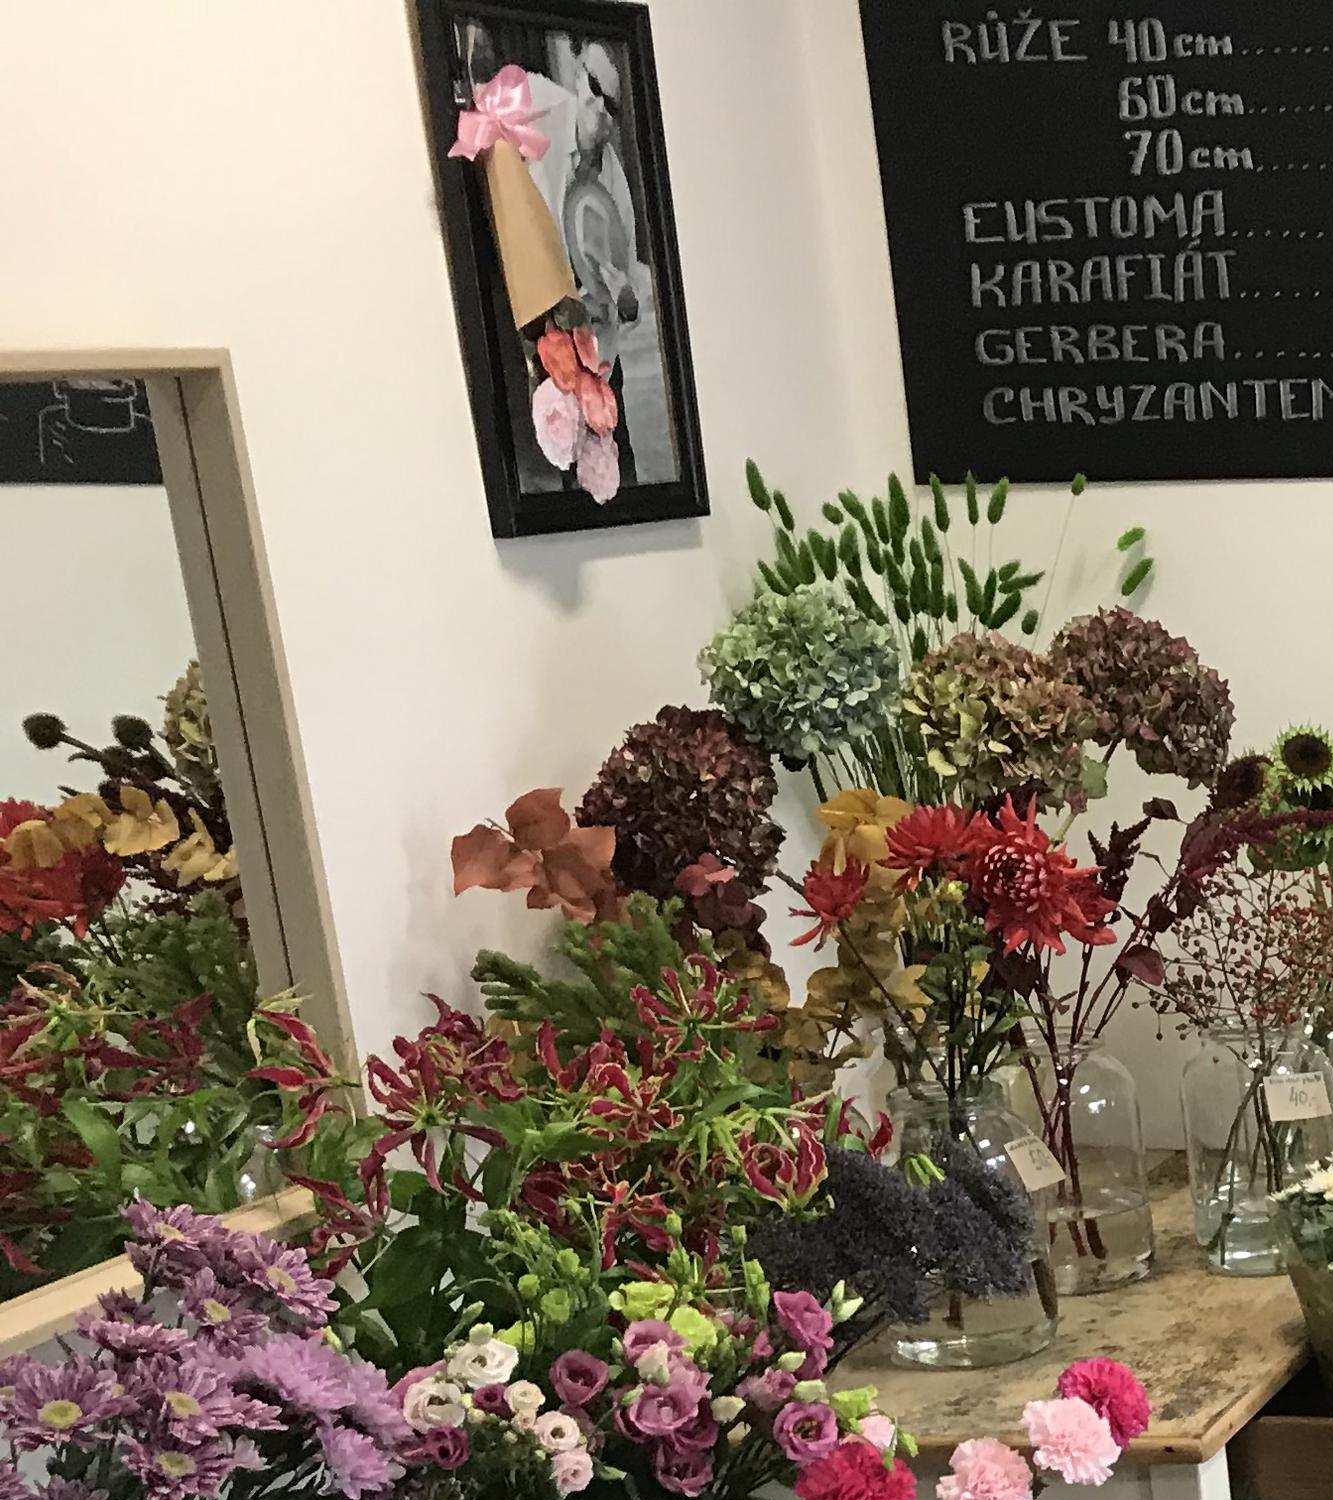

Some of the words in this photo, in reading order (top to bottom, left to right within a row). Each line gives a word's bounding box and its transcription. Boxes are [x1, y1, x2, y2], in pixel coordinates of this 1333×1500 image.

[941, 8, 1088, 64] RŮŽE
[962, 188, 1226, 244] EUSTOMA
[971, 237, 1238, 308] KARAFIÁT
[974, 321, 1225, 365] GERBERA
